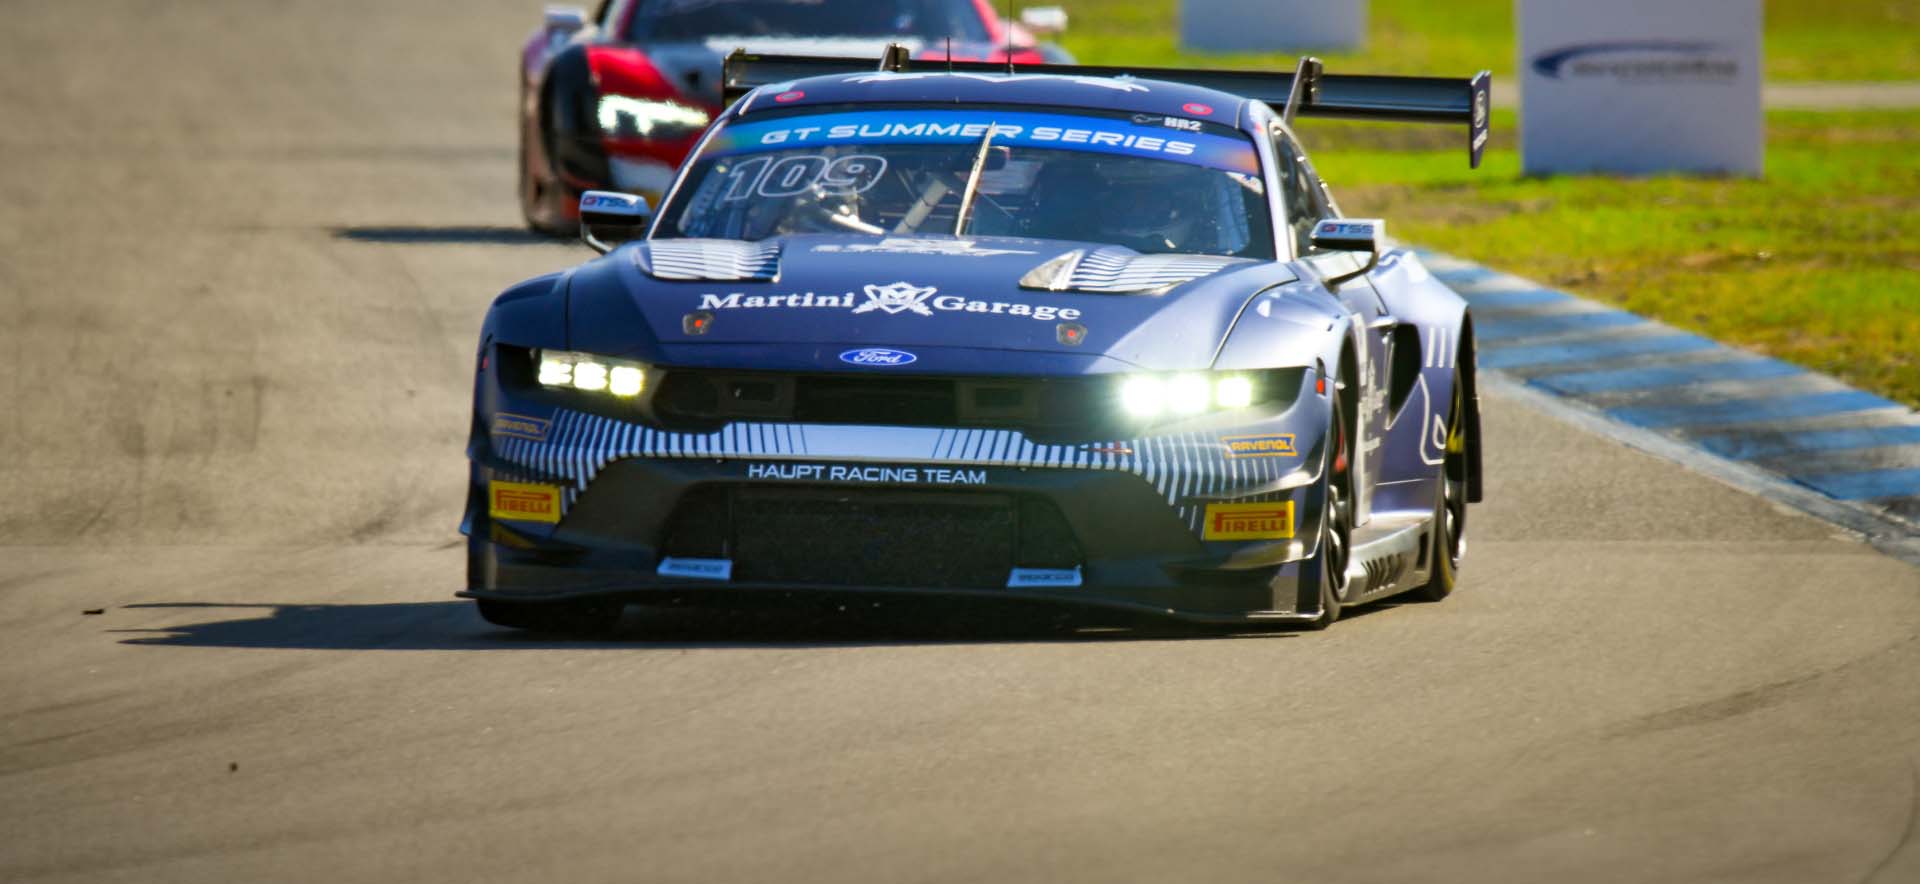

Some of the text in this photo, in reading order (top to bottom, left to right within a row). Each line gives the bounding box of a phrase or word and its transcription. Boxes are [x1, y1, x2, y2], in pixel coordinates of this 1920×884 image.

[761, 122, 1196, 155] GT SUMMER SERIES
[729, 155, 887, 201] 109
[1321, 223, 1374, 234] GTSS
[700, 291, 1081, 321] Martini Garage
[854, 349, 902, 366] Ford
[748, 463, 987, 484] HAUPT RACING TEAM
[495, 489, 553, 514] PIRELLI
[1214, 510, 1287, 533] PIRELLI
